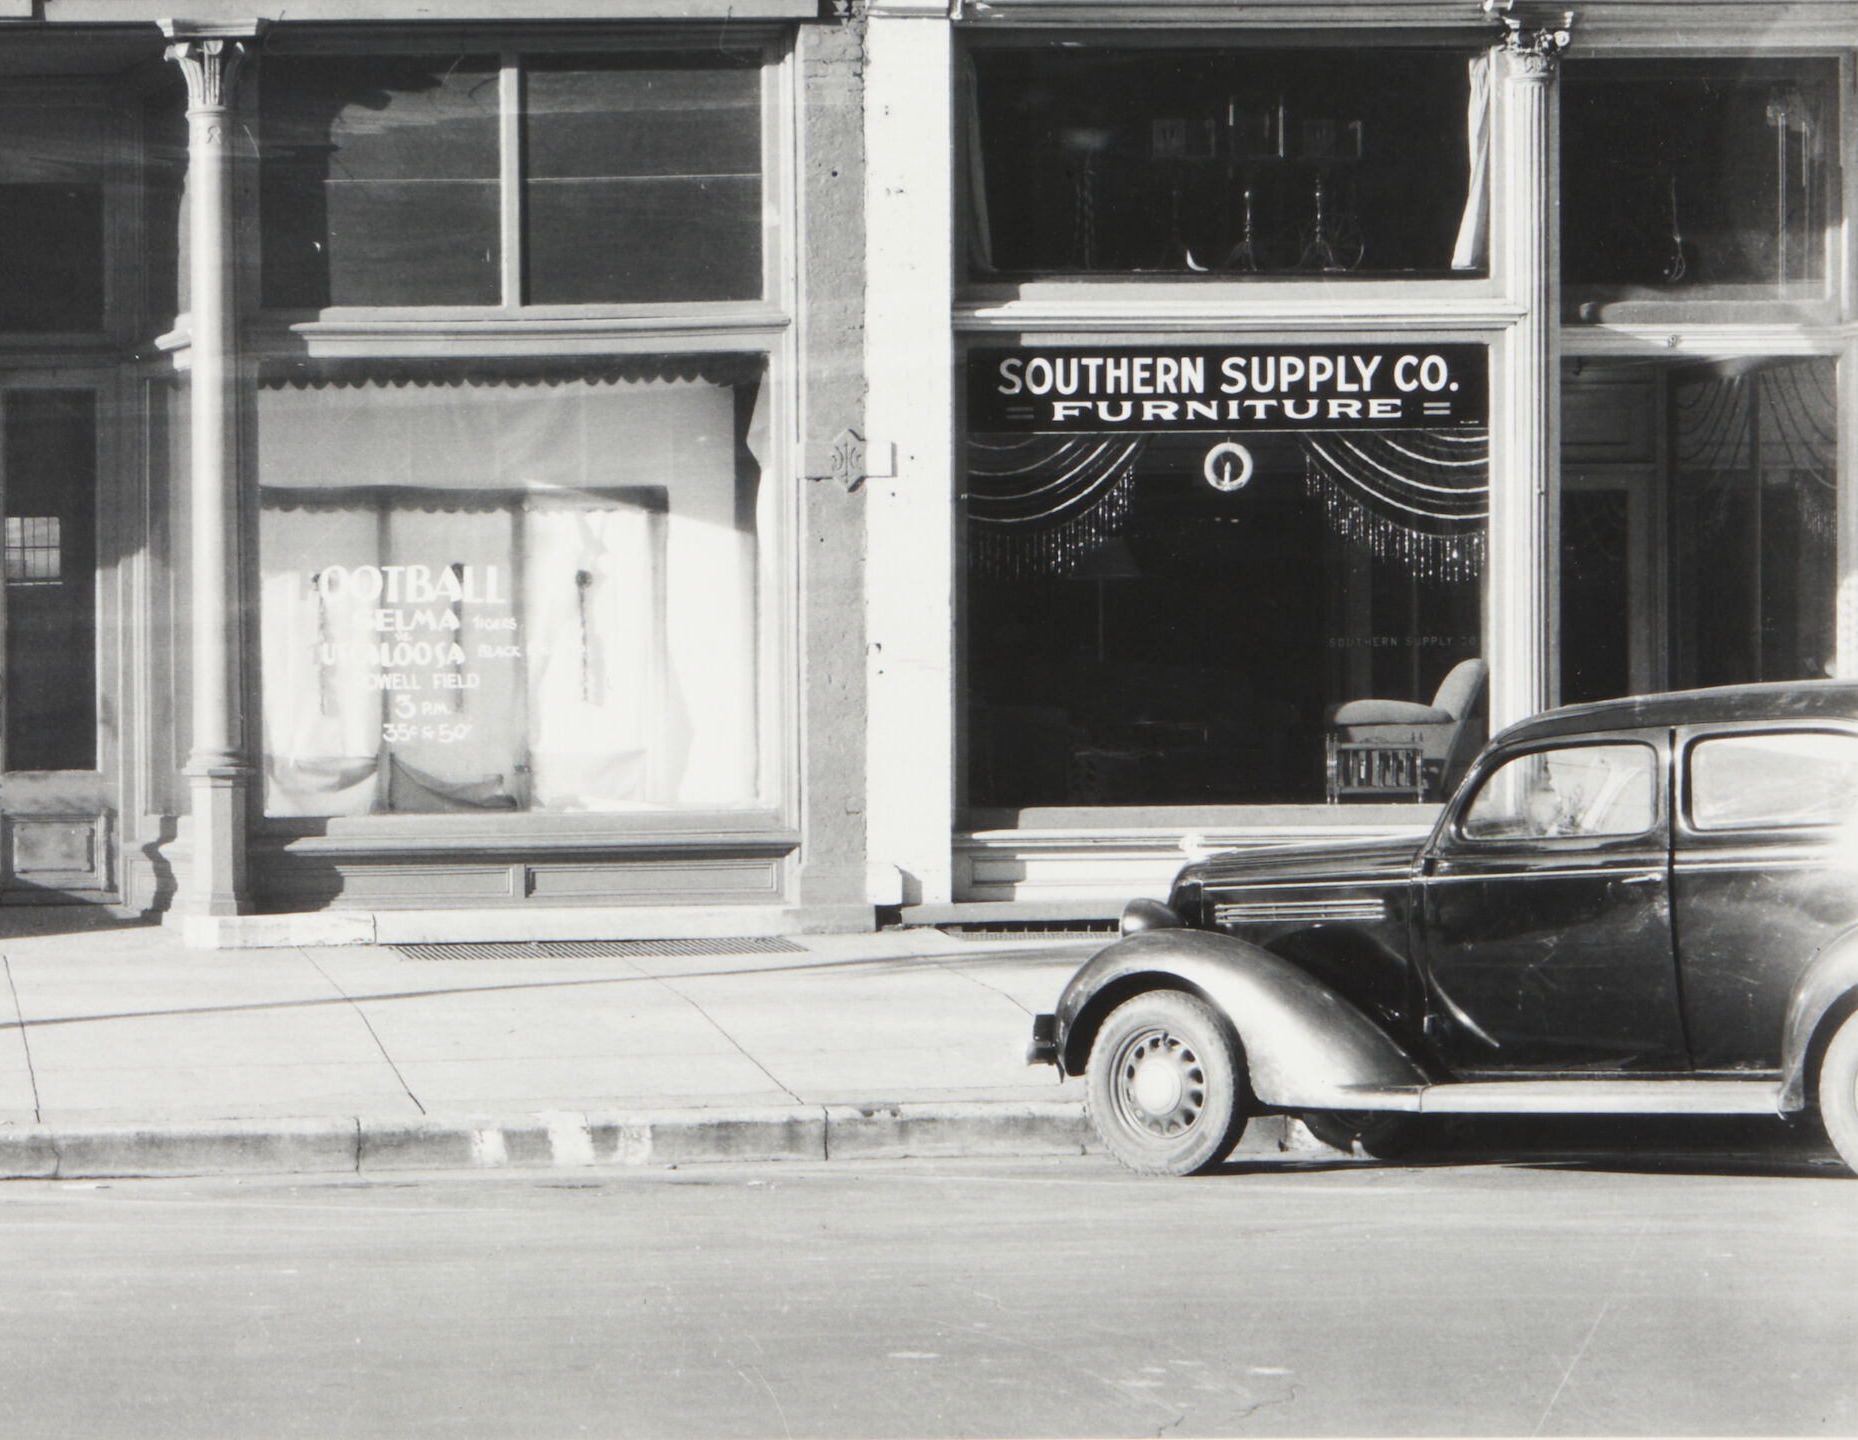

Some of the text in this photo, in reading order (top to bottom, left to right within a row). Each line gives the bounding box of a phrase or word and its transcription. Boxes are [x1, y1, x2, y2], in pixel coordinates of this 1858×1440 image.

[998, 355, 1459, 395] SOUTHERN SUPPLY CO.
[1052, 399, 1402, 422] FURNITURE
[314, 564, 507, 603] OOTBALL
[351, 608, 460, 631] SELMA
[1328, 636, 1398, 648] SOUTHERN
[1405, 635, 1454, 648] SUPPLY
[432, 672, 480, 690] FIELD
[394, 694, 416, 719] 3
